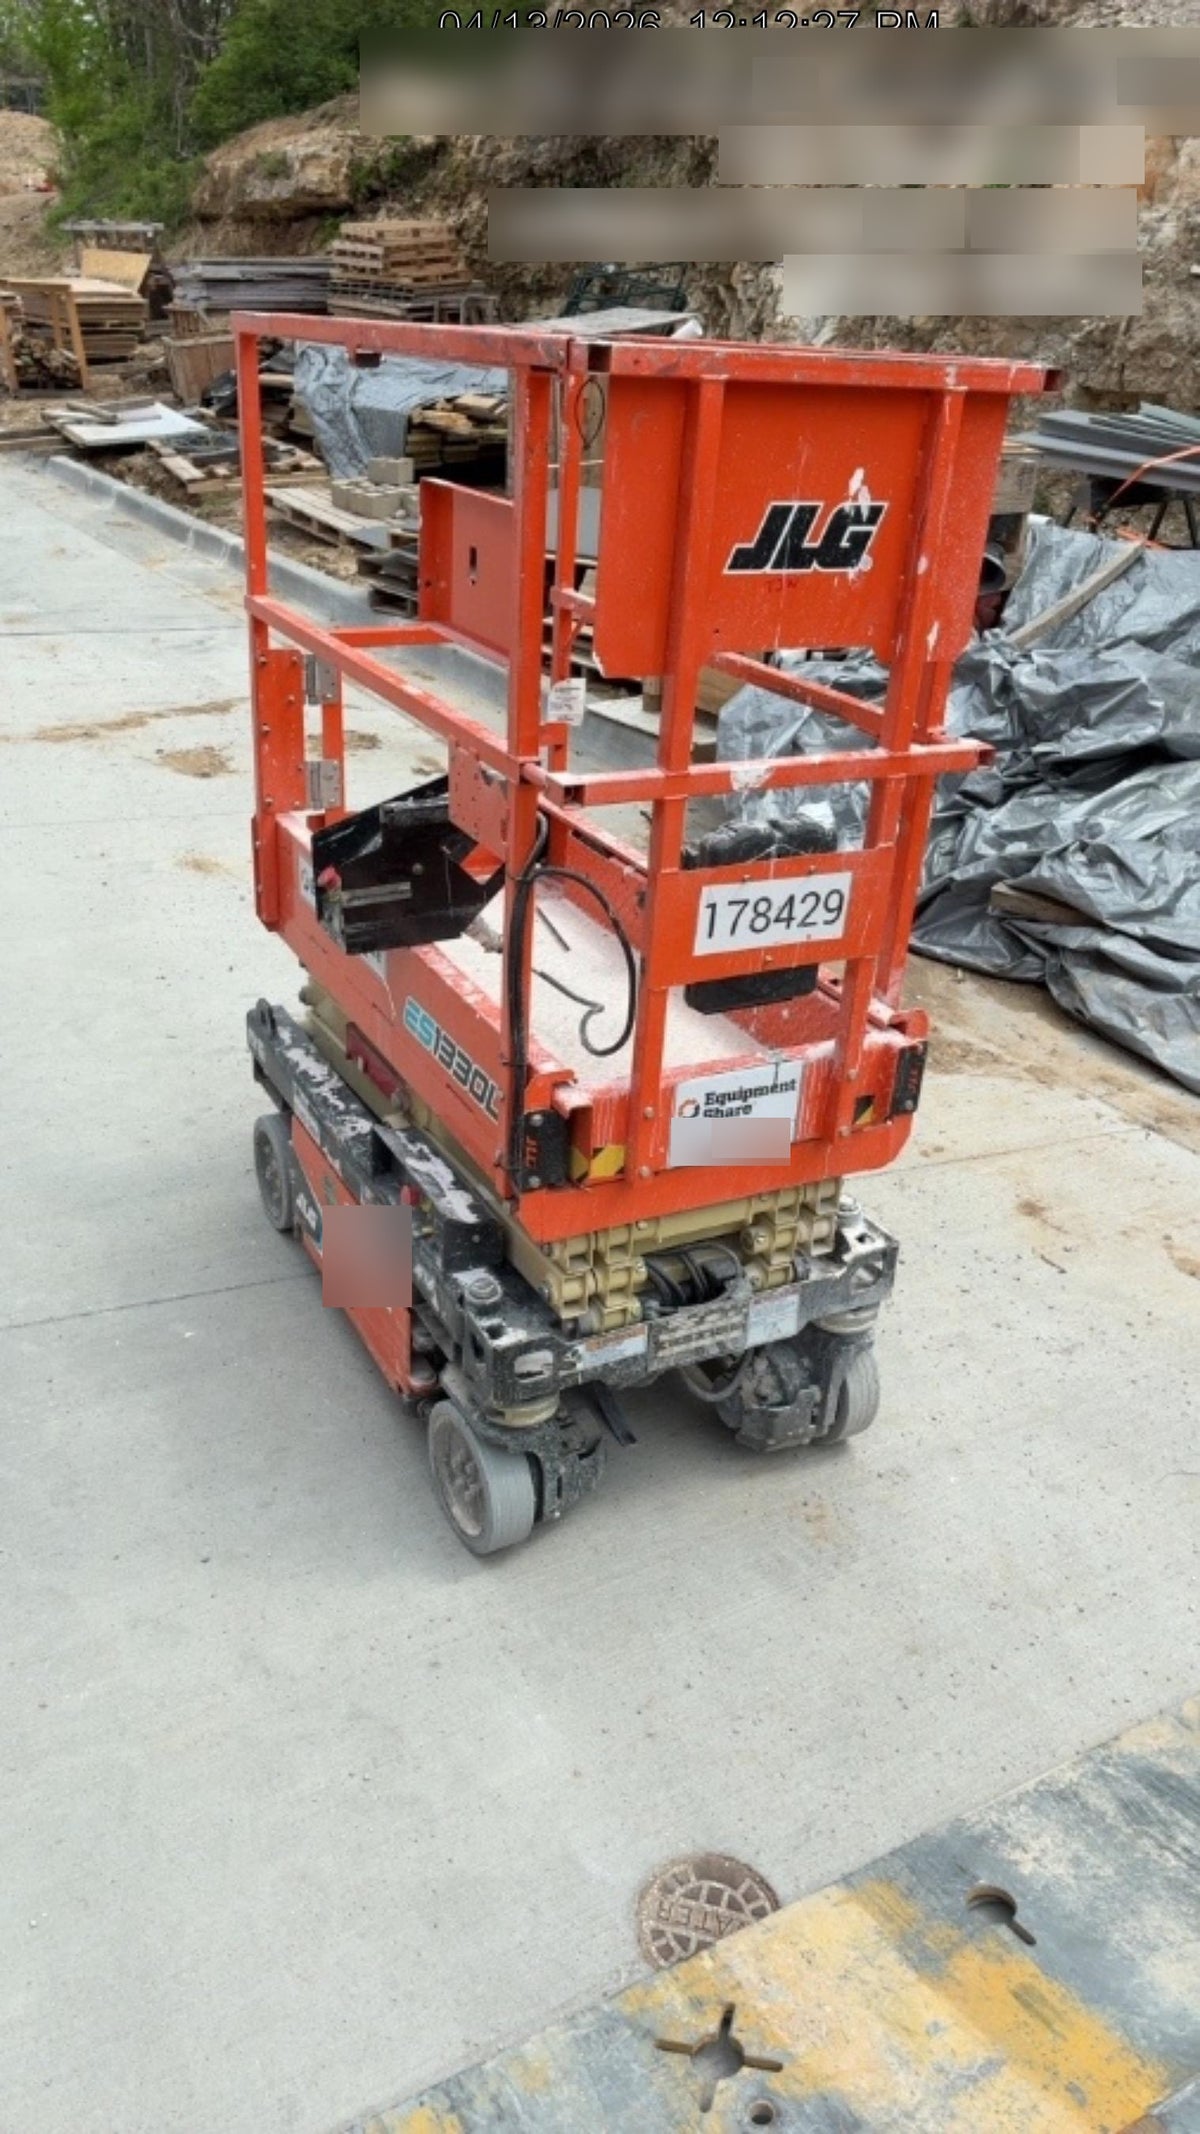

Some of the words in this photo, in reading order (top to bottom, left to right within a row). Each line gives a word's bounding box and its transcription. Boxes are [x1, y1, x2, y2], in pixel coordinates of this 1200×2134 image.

[723, 501, 888, 574] JLG
[704, 888, 845, 939] 178429
[404, 996, 498, 1123] ES1330L
[704, 1079, 797, 1106] Equipment
